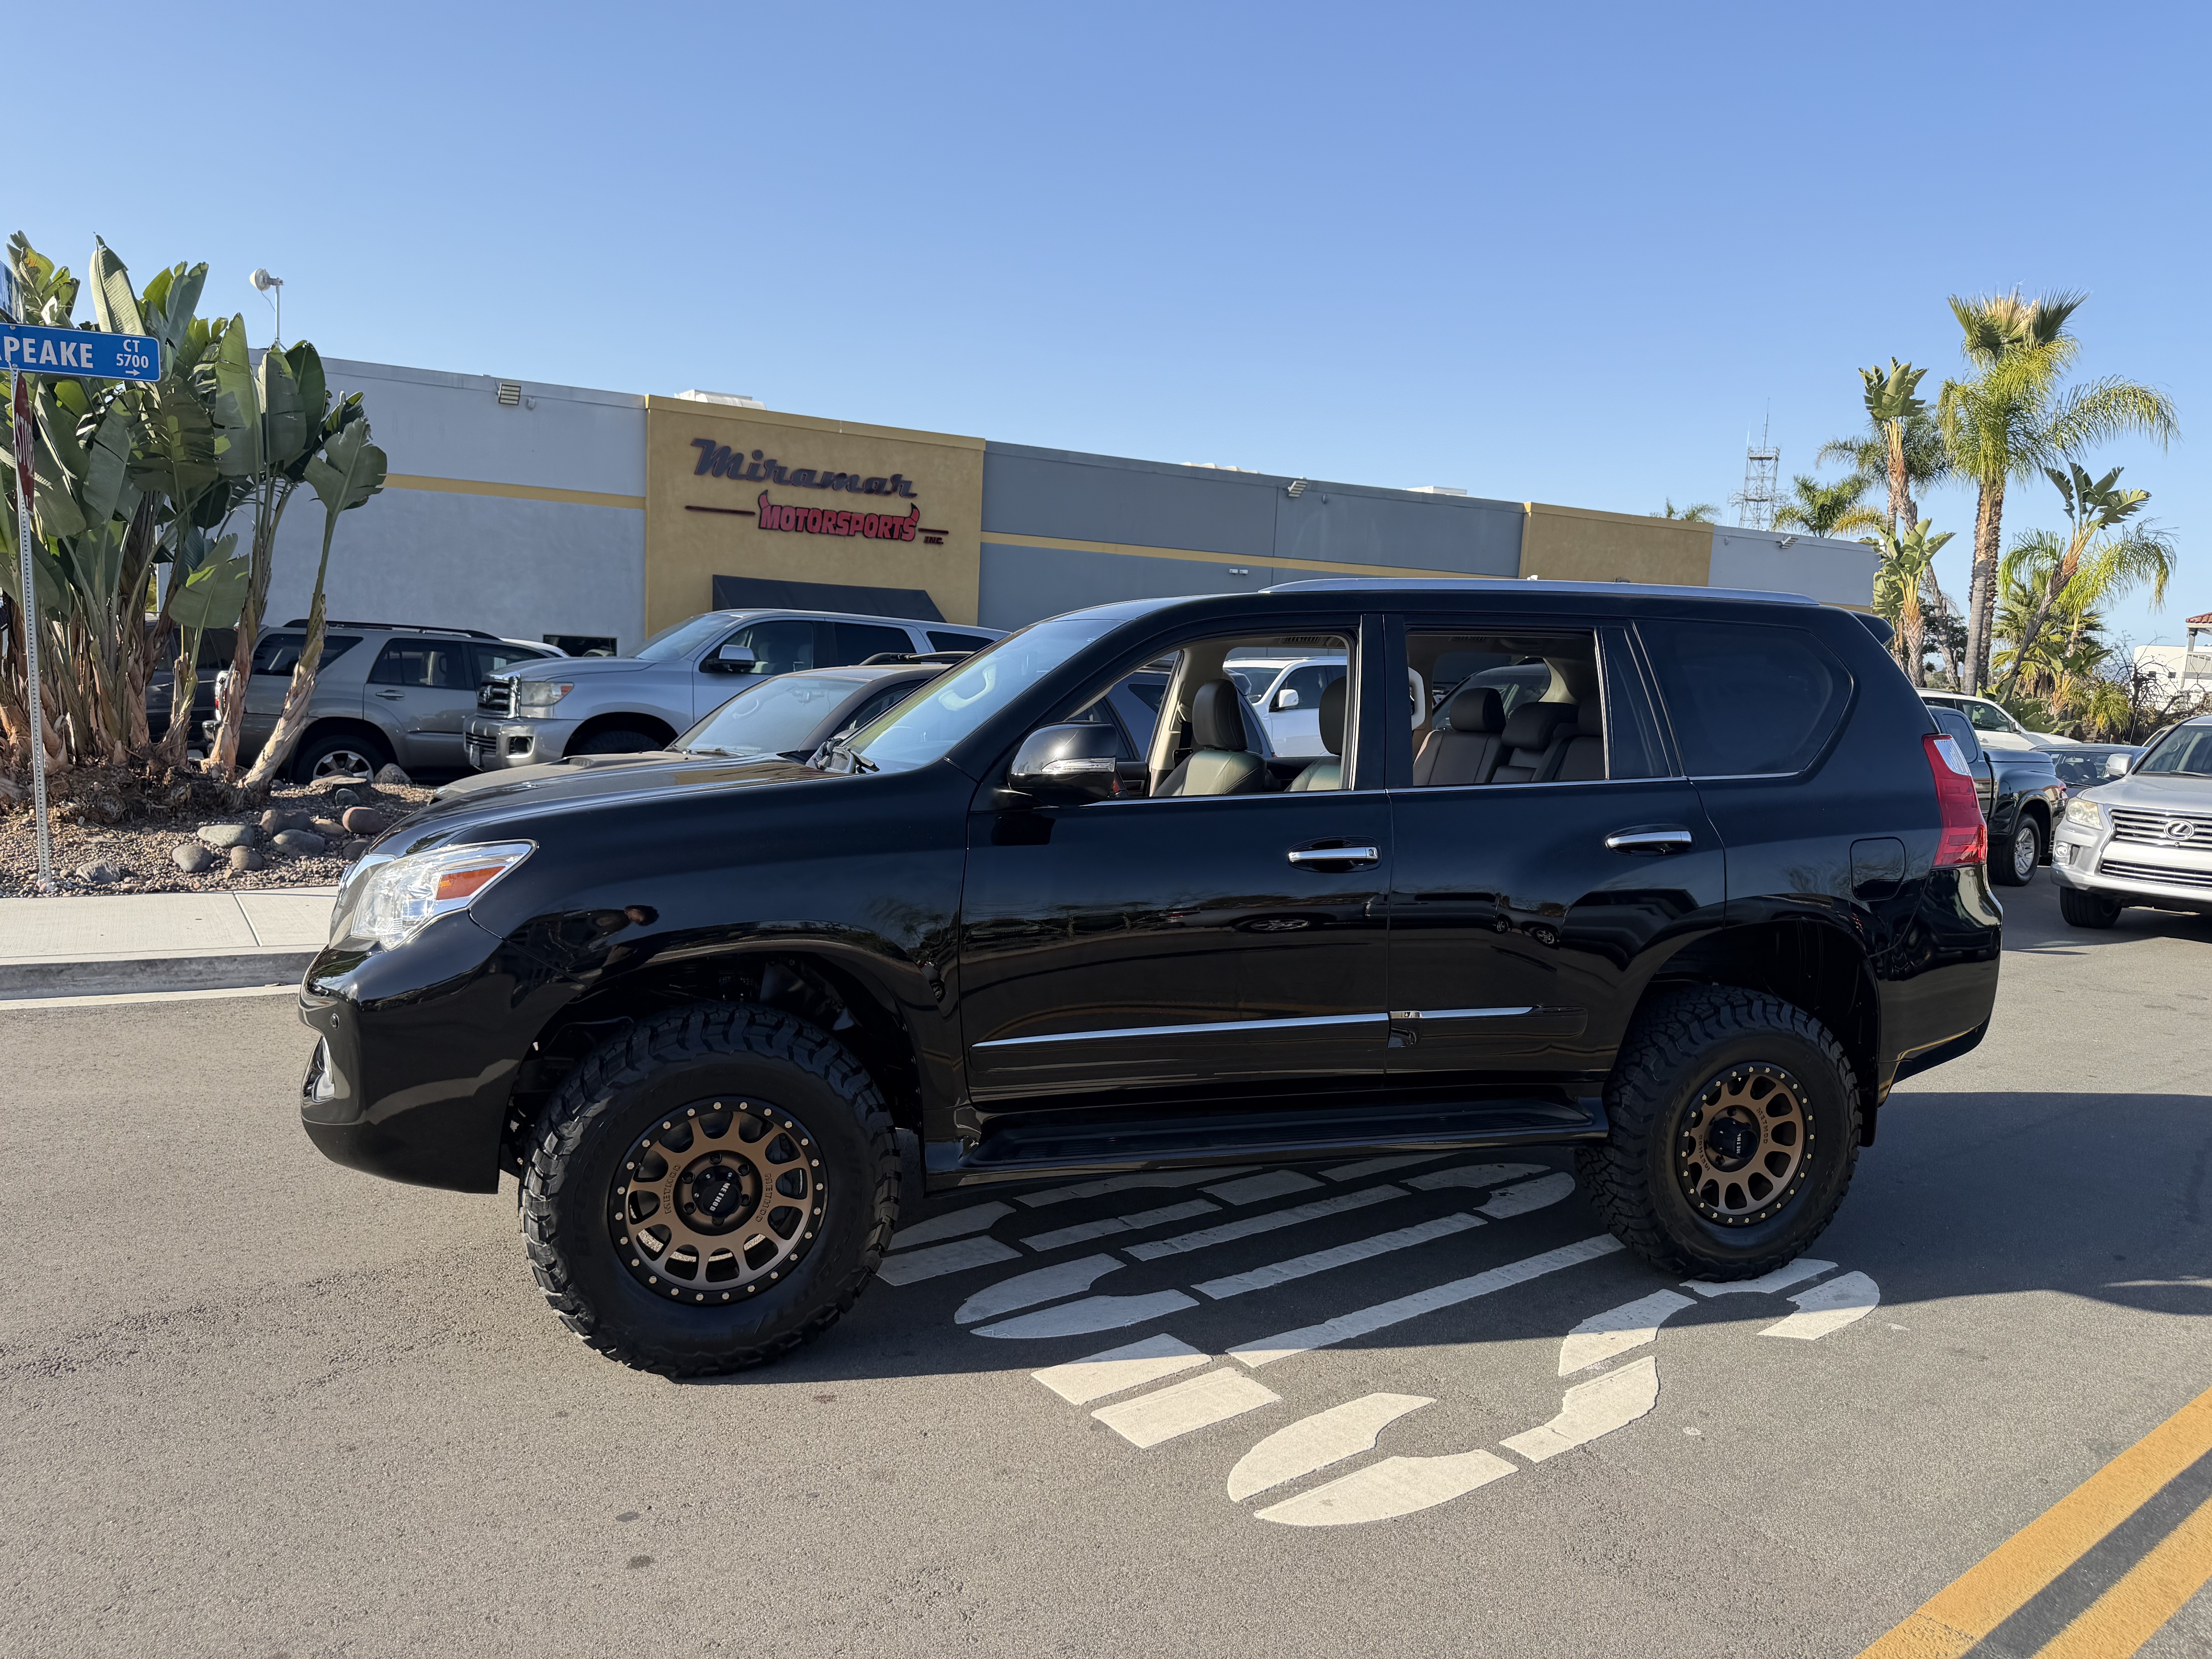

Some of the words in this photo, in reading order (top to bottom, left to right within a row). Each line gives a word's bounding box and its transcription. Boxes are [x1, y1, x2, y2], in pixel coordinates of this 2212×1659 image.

[0, 336, 93, 368] PEAKE
[116, 354, 149, 368] 5700
[123, 339, 140, 353] CT
[16, 412, 33, 468] STOP
[690, 438, 917, 498] Miramar
[758, 500, 919, 541] MOTORSPORTS
[924, 536, 943, 544] INC.
[1757, 1108, 1768, 1144] METHOD
[663, 1164, 681, 1214] METHOD
[709, 1182, 730, 1211] METHOD
[756, 1173, 773, 1222] METHOD
